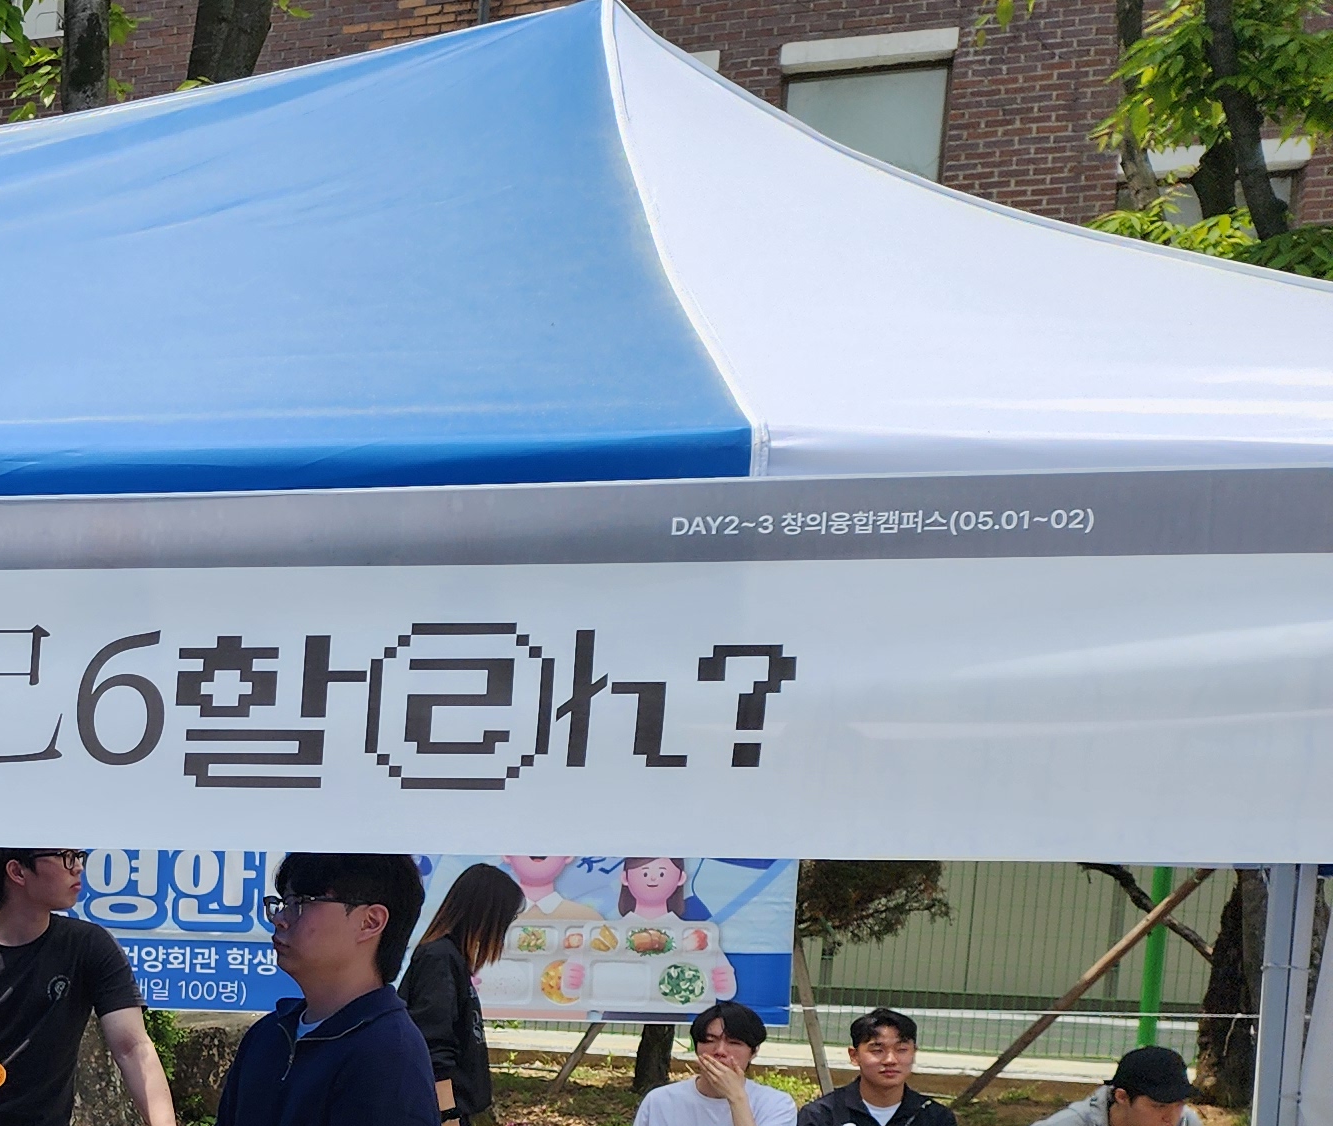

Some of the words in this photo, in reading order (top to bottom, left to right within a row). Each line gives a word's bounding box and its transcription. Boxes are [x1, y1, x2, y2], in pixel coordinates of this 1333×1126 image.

[671, 514, 774, 536] DAY2~3
[781, 508, 1095, 535] 창의융합캠퍼스(05.01~02)
[177, 979, 248, 1007] 100명)
